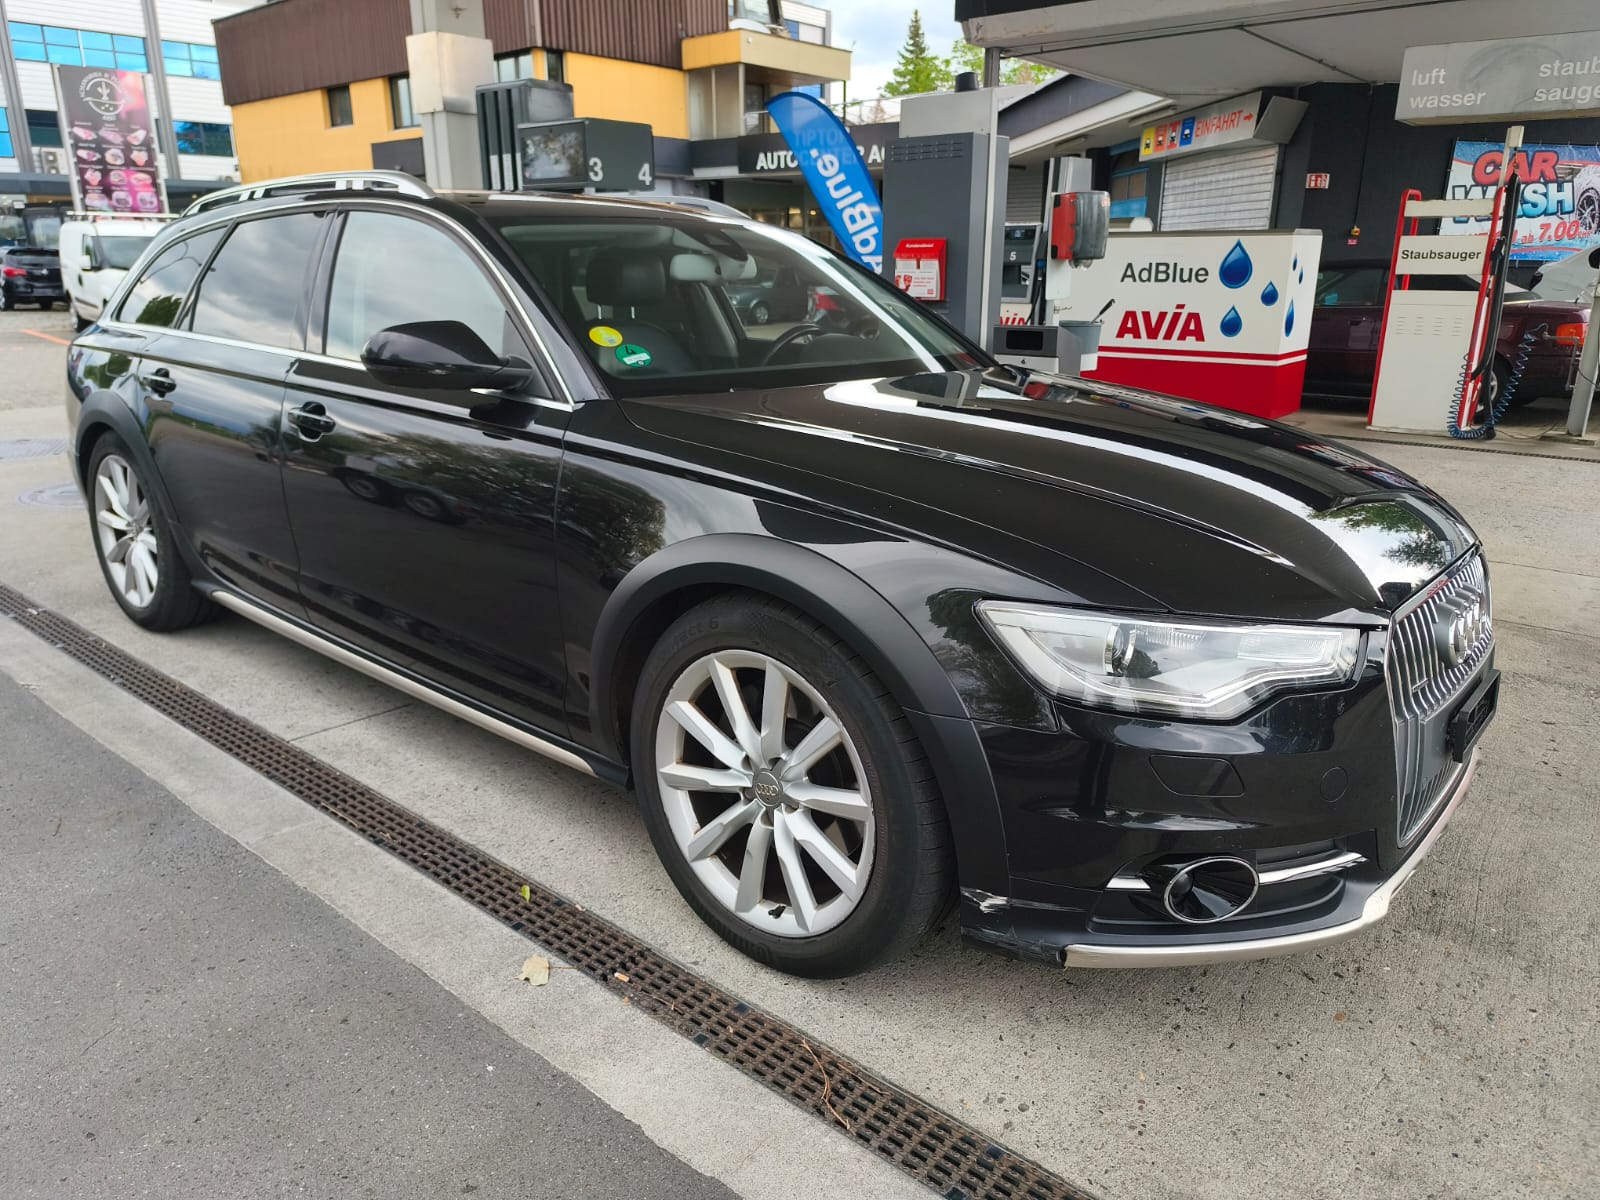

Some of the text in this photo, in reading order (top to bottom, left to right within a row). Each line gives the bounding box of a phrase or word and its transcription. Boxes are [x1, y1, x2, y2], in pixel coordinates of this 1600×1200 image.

[1411, 68, 1447, 87] luft
[1538, 56, 1600, 78] staub
[1409, 91, 1487, 110] wasser
[1195, 109, 1245, 138] EINFAHRT
[867, 144, 885, 164] A
[588, 157, 604, 182] 3
[637, 163, 653, 186] 4
[1472, 150, 1560, 186] CAR
[1452, 180, 1576, 224] WSH
[1521, 232, 1535, 244] ab
[1538, 219, 1581, 243] 7.00
[1009, 251, 1017, 261] 5
[1401, 249, 1482, 262] Staubsauger
[1120, 262, 1209, 283] AdBlue
